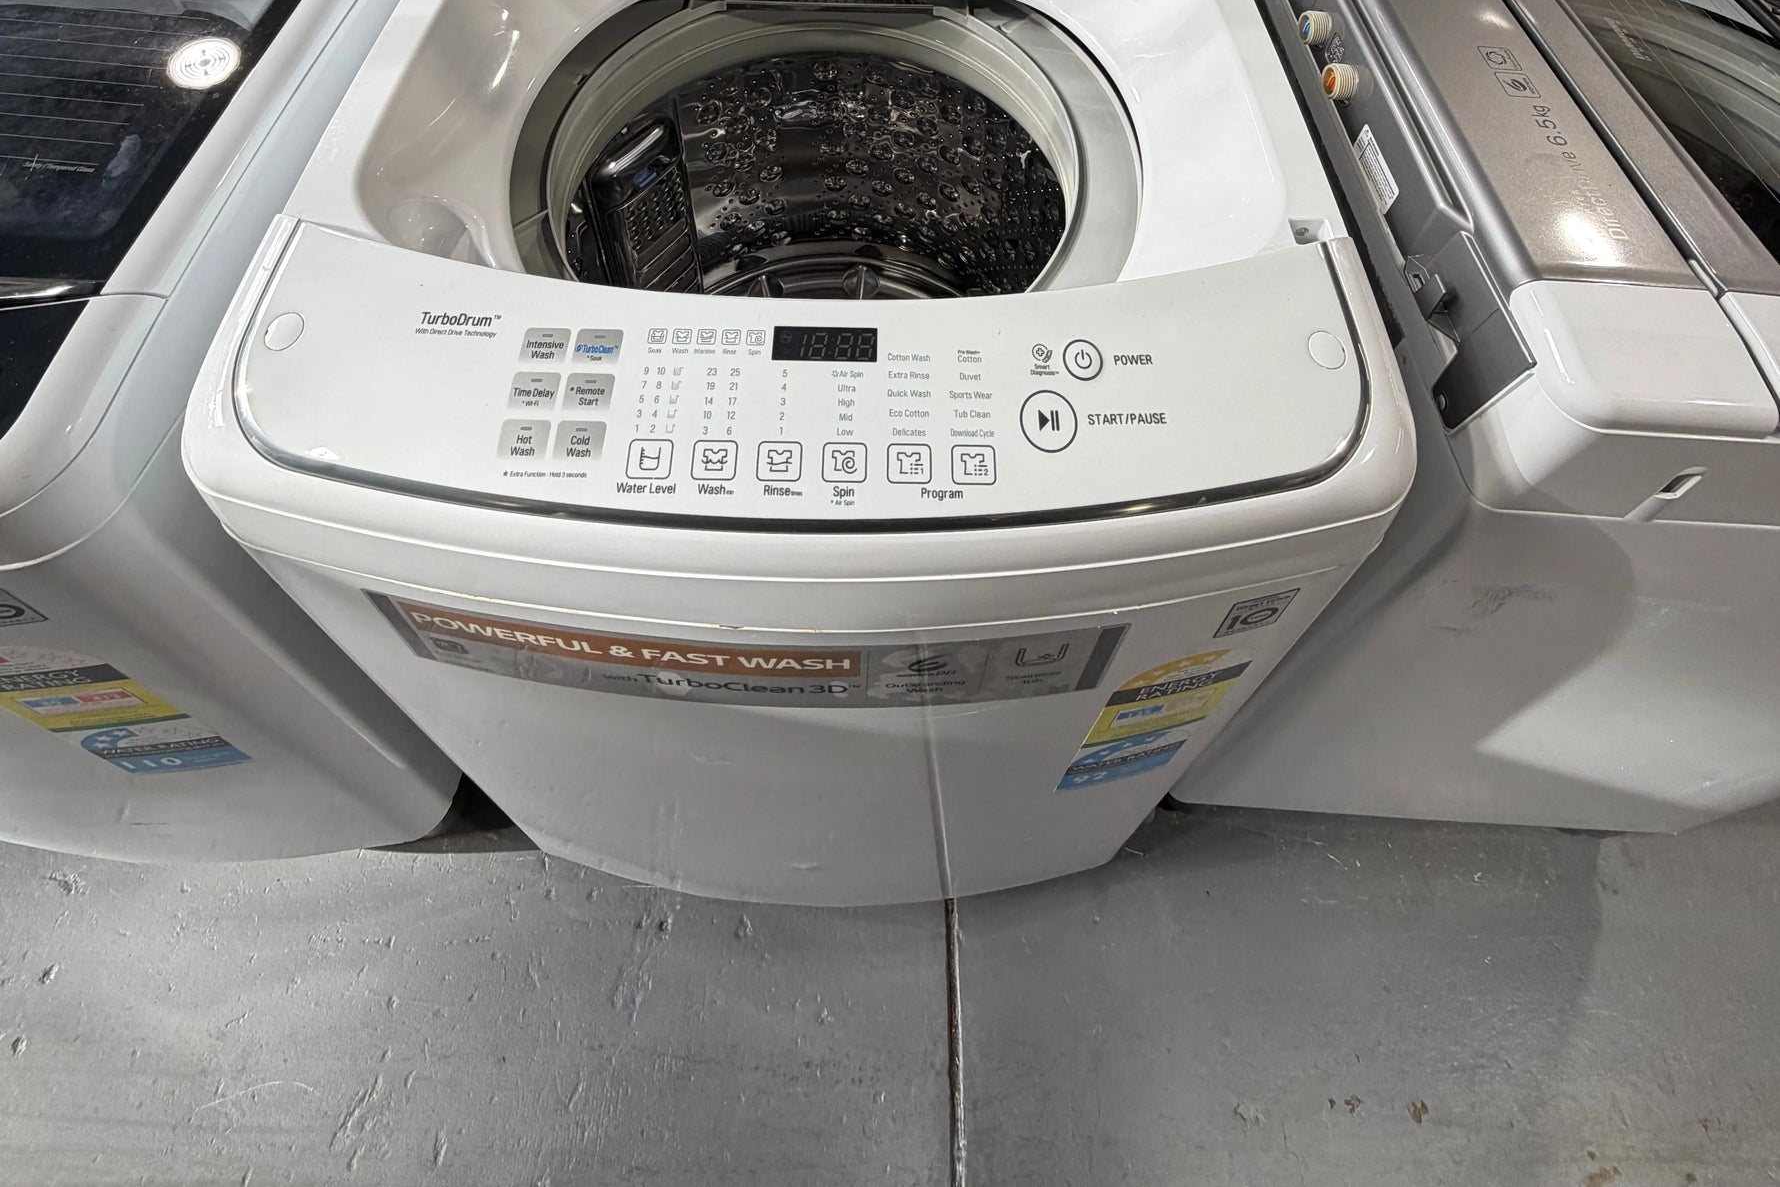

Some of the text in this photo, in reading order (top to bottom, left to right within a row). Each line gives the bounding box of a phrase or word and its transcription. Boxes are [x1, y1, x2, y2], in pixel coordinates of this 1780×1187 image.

[464, 330, 497, 338] Technology
[526, 340, 564, 349] Intensive
[531, 351, 555, 359] Wash
[887, 353, 931, 363] Cotton Wash
[957, 355, 982, 364] Cotton
[1113, 354, 1154, 366] POWER
[643, 366, 666, 375] 9 10
[706, 367, 741, 377] 23 25
[782, 369, 788, 378] 5
[839, 370, 864, 380] Air Spin
[888, 371, 930, 380] Extra Rinse
[959, 372, 982, 381] Duvet
[642, 380, 662, 390] 7 8
[706, 382, 739, 391] 19 21
[781, 383, 787, 392] 4
[837, 384, 856, 393] Ultra
[513, 387, 555, 400] Time Delay
[575, 387, 606, 396] Remote
[887, 389, 932, 399] Quick Wash
[949, 391, 992, 401] Sports Wear
[578, 397, 599, 406] Start
[638, 395, 660, 404] 5 6
[704, 396, 737, 406] 14 17
[780, 398, 786, 406] 3
[837, 398, 855, 408] High
[636, 409, 658, 418] 3 4
[703, 410, 736, 420] 10 12
[779, 412, 785, 421] 2
[838, 413, 853, 422] Mid
[889, 409, 930, 418] Eco Cotton
[954, 410, 991, 419] Tub Clean
[1087, 413, 1167, 426] START/PAUSE
[649, 424, 656, 433] 2
[702, 426, 733, 436] 3 6
[836, 428, 854, 436] Low
[892, 428, 927, 437] Delicates
[950, 429, 995, 438] Download Cycle
[516, 435, 532, 444] Hot
[570, 436, 590, 446] Cold
[510, 447, 535, 456] Wash
[566, 448, 591, 458] Wash
[616, 482, 677, 494] Water Level
[697, 484, 726, 495] Wash
[763, 485, 791, 496] Rinse
[832, 486, 855, 499] Spin
[920, 487, 964, 501] Program
[844, 499, 855, 507] Spin
[410, 611, 603, 656] POWERFUL
[609, 645, 635, 659] &
[641, 648, 731, 667] FAST
[737, 656, 851, 671] WASH
[0, 669, 80, 686] NERGY
[1, 676, 92, 692] RATING
[637, 673, 806, 695] TurboClean
[1138, 671, 1222, 695] ENERGY
[1135, 680, 1214, 702] RATING
[158, 736, 222, 749] RATING
[1070, 742, 1184, 771] WATER RATING
